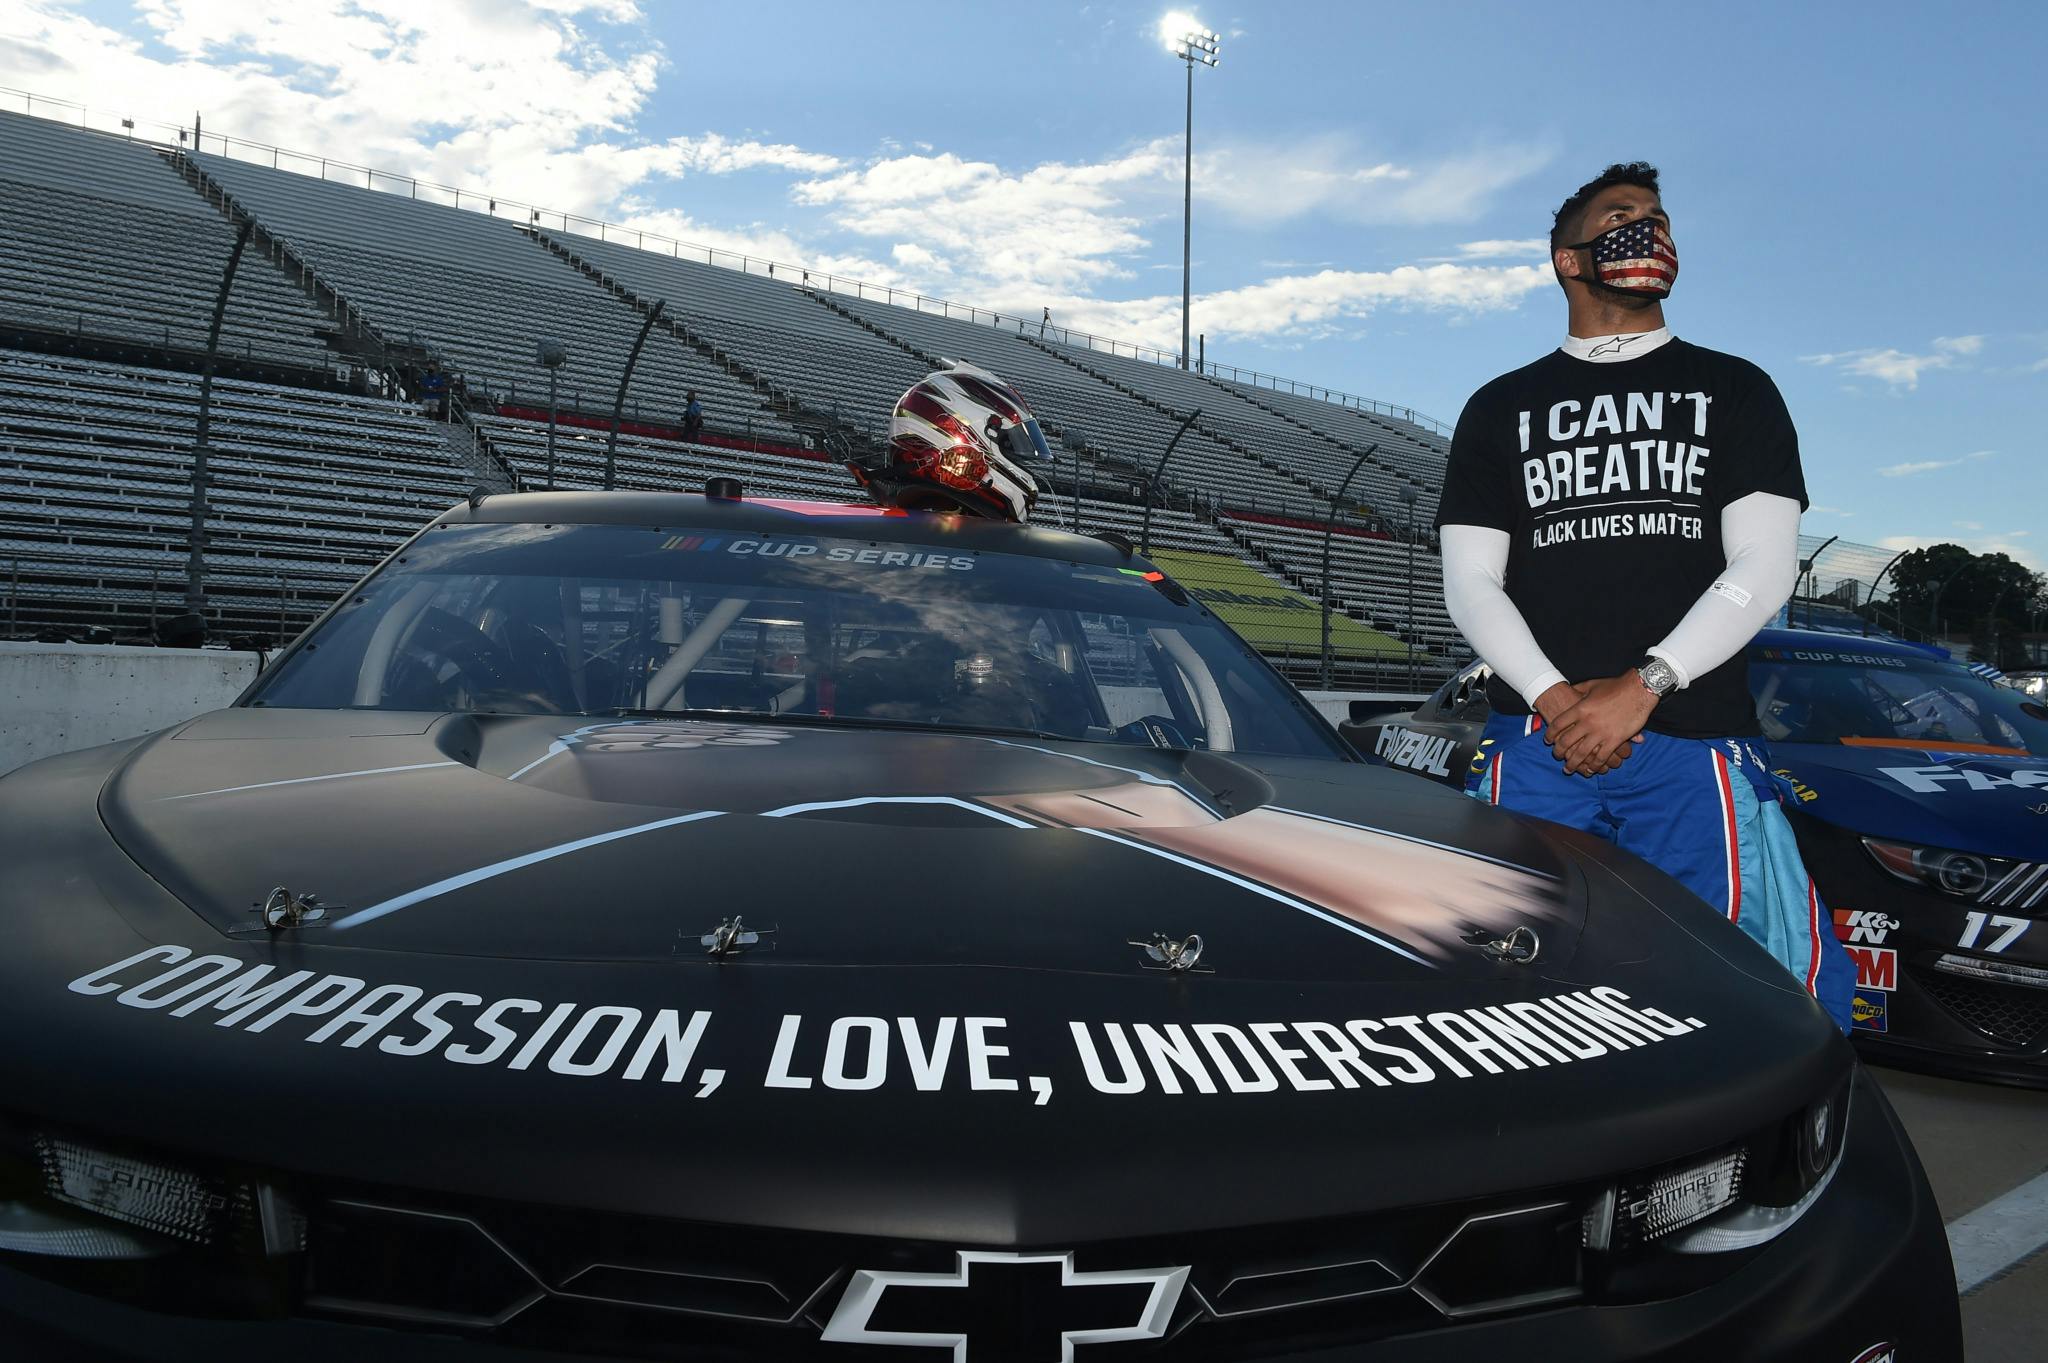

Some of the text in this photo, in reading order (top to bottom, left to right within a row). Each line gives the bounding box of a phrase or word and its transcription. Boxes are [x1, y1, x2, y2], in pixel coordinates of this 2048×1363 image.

[1518, 391, 1713, 453] I CAN'T
[1523, 440, 1710, 509] BREATHE
[1533, 512, 1702, 549] BLACK LIVES MATTER
[726, 539, 975, 572] CUP SERIES
[1794, 652, 1906, 668] CUP SERIES
[1374, 724, 1457, 777] FASTENAL
[1957, 911, 2031, 953] 17
[67, 944, 1707, 1106] COMPASSION, LOVE, UNDERSTANDING.
[1852, 1003, 1883, 1018] NOCO
[1629, 1171, 1718, 1220] CAMARO
